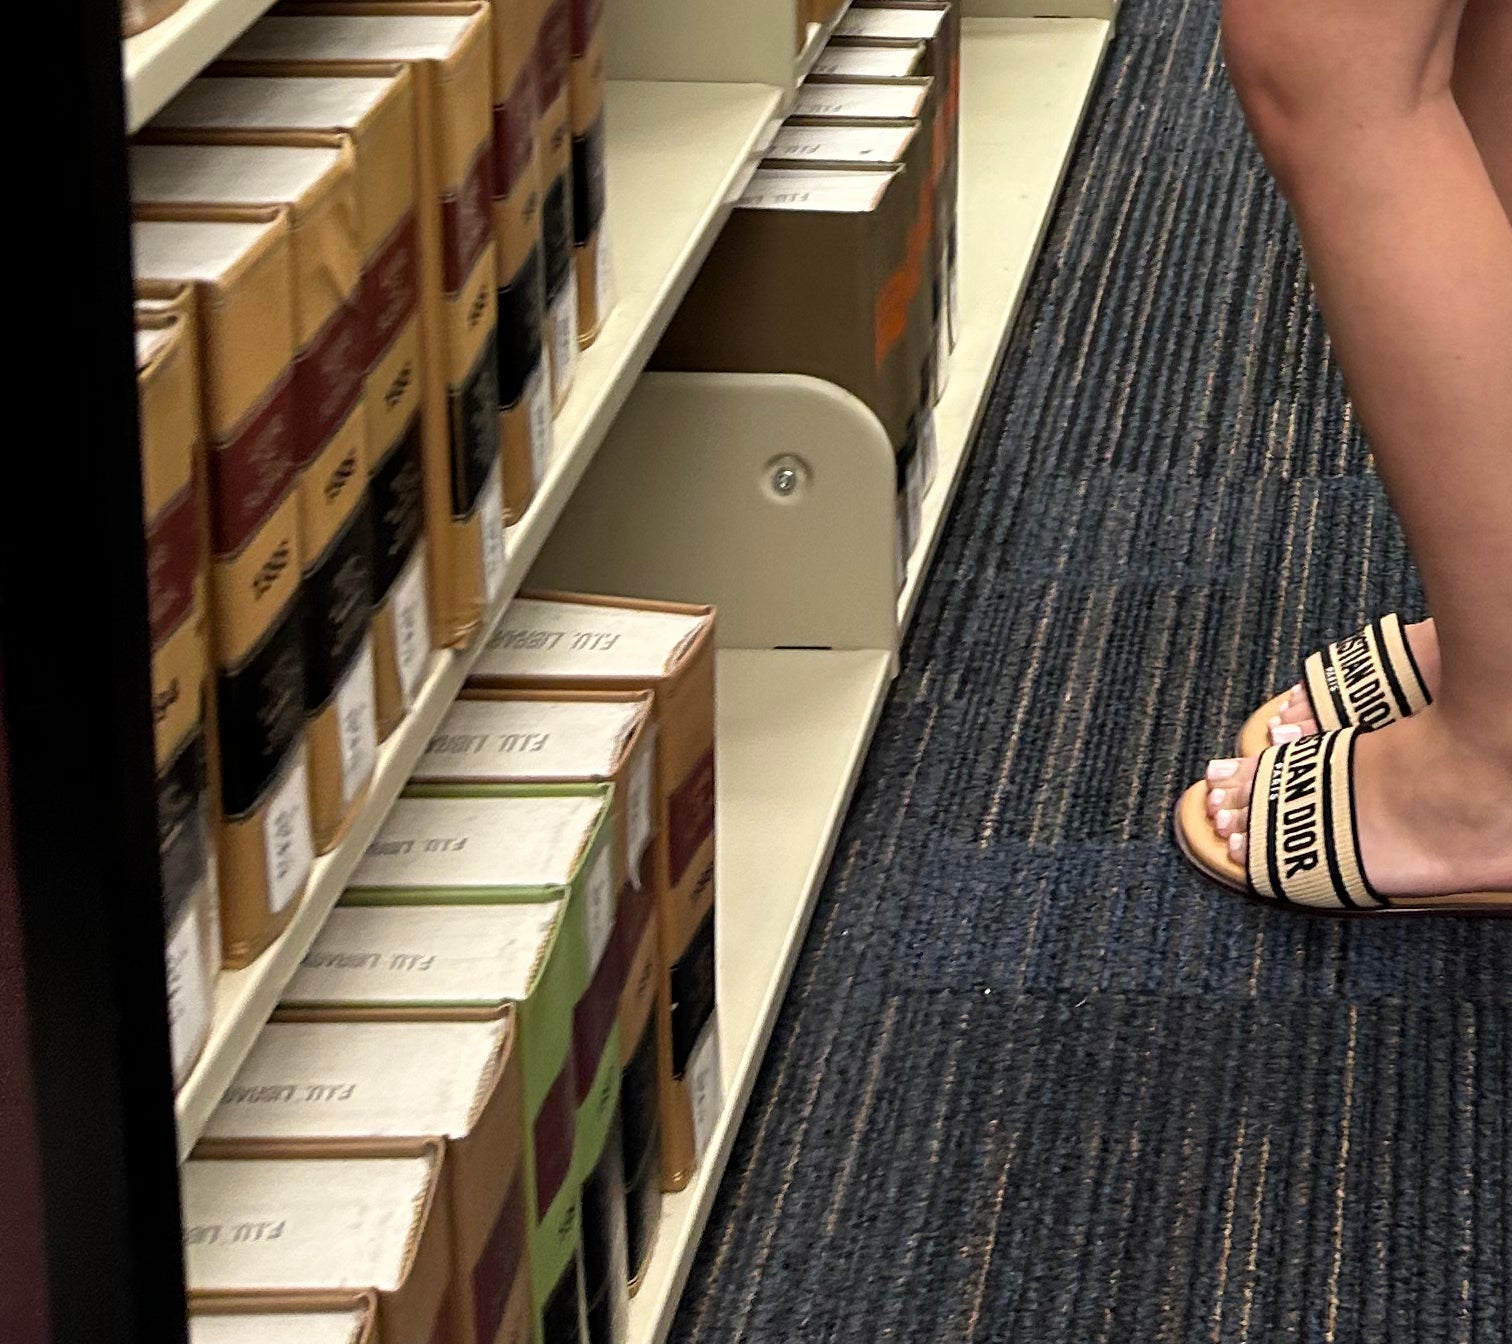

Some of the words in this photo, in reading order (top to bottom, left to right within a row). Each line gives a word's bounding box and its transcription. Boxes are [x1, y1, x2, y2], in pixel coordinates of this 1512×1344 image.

[1349, 678, 1396, 731] DIO
[1268, 762, 1284, 802] PARIS
[1283, 802, 1319, 879] DIOR
